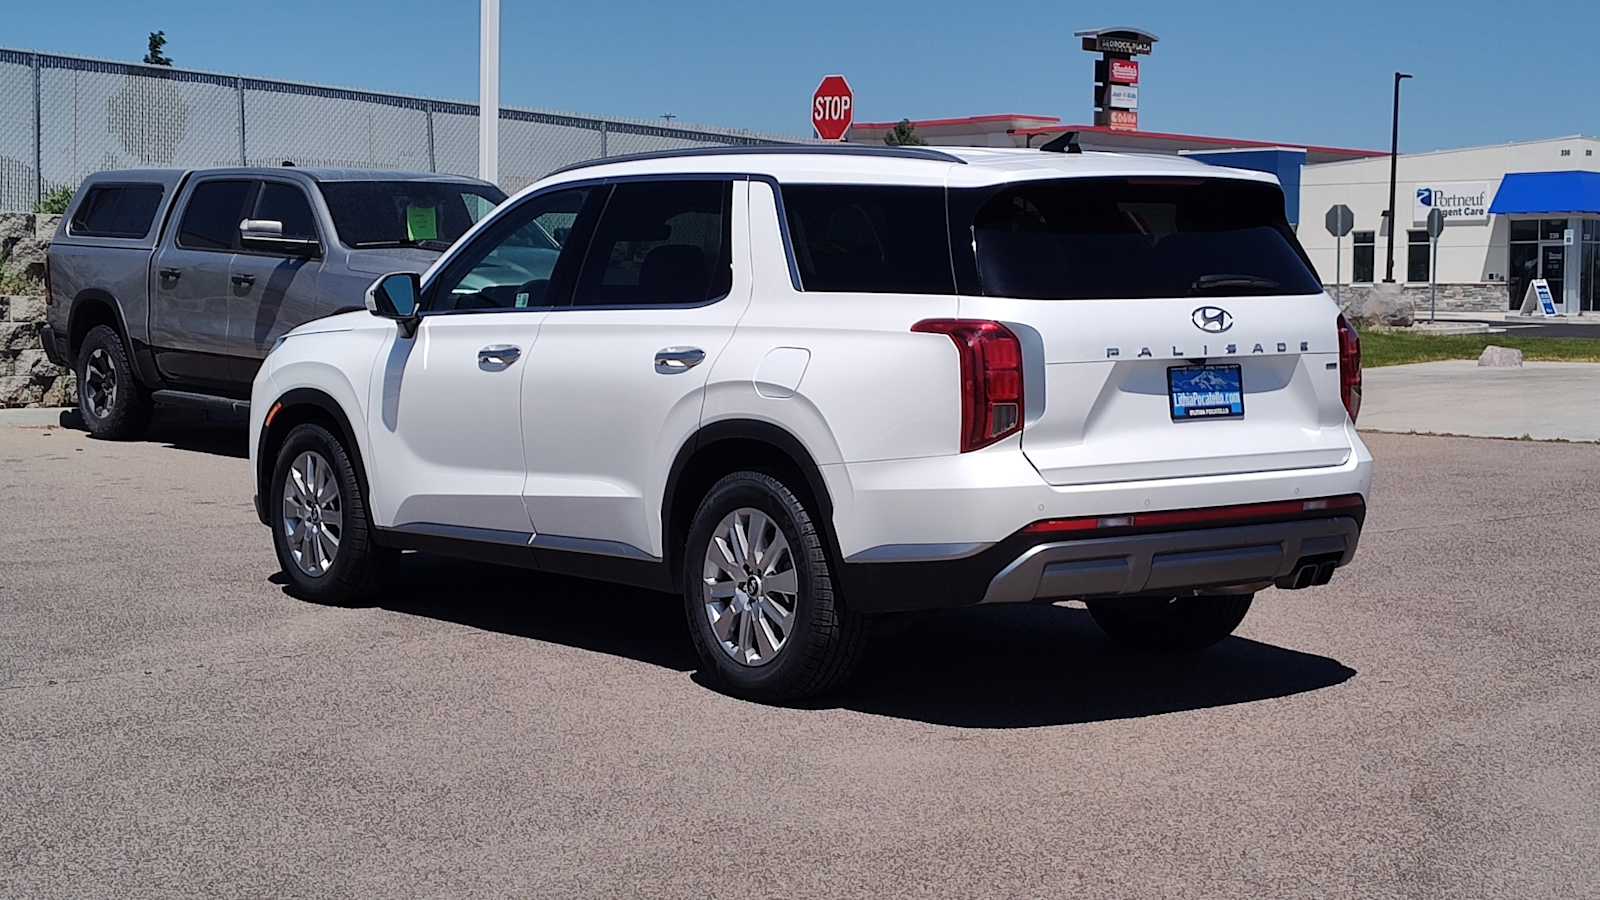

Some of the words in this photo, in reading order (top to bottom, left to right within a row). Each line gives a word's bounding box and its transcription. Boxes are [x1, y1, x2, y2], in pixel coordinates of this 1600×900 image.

[814, 96, 850, 120] STOP
[1433, 190, 1485, 207] Portneuf
[1441, 208, 1462, 218] gent
[1464, 207, 1484, 216] Care
[1106, 341, 1308, 358] PALISADE
[1173, 391, 1241, 407] LithiaPocatello.com
